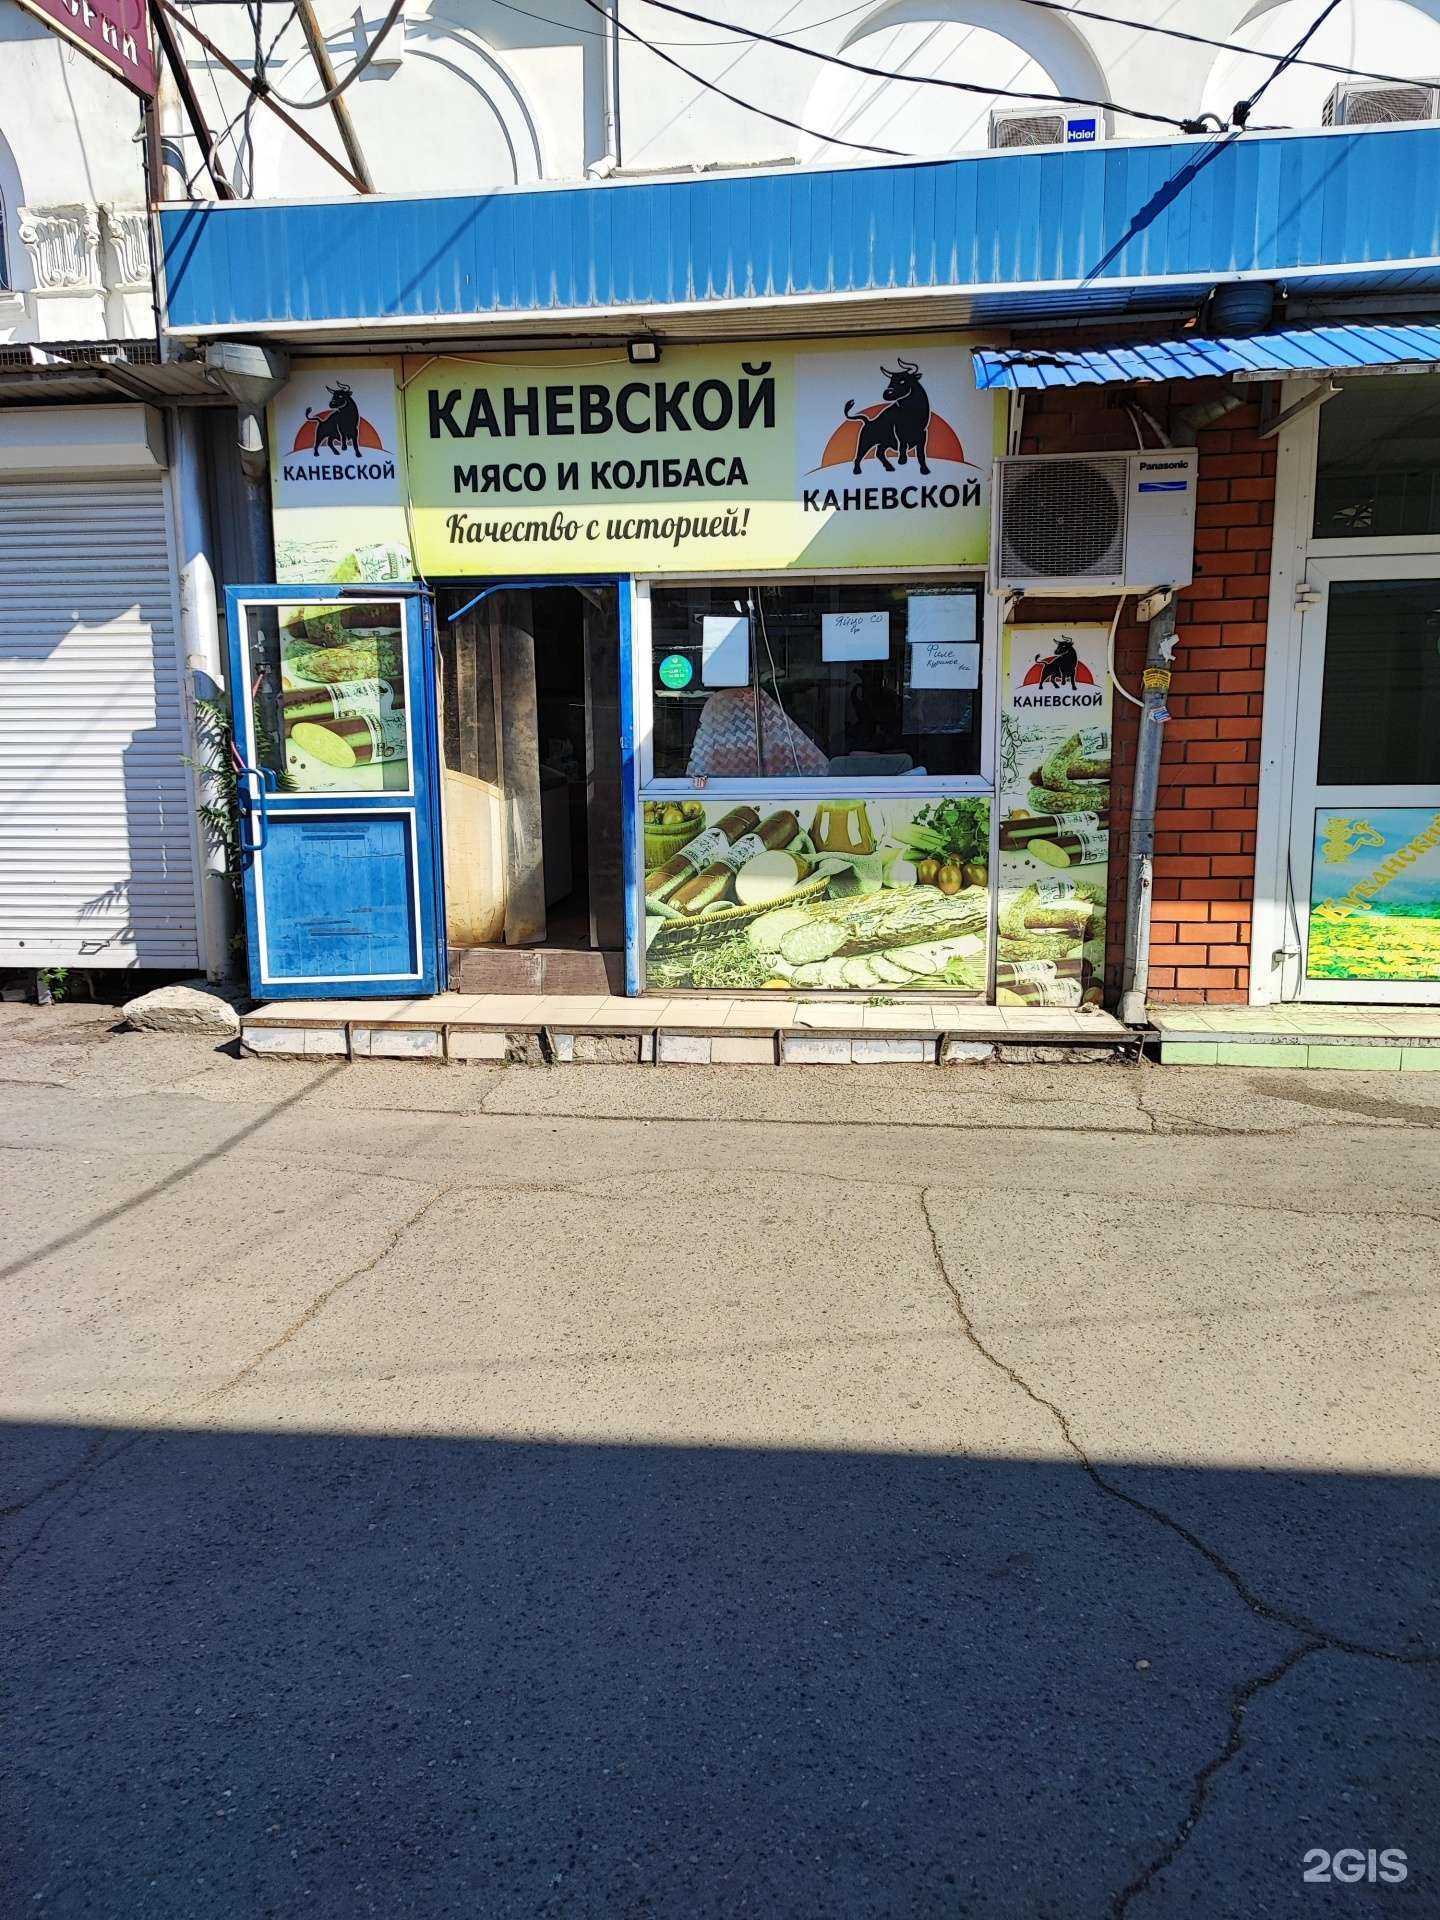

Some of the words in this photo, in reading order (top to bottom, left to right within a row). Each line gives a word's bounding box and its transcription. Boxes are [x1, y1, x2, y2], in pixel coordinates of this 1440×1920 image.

[1068, 130, 1095, 139] Haier
[428, 361, 776, 438] КАНЕВСКОЙ
[283, 460, 395, 481] КАНЕВСКОЙ
[453, 463, 546, 493] МЯСО
[557, 462, 579, 490] И
[591, 457, 749, 490] КОЛБАСА
[1140, 461, 1188, 471] Panasonic
[803, 478, 981, 512] КАНЕВСКОЙ
[446, 511, 583, 544] Качество
[586, 520, 600, 541] с
[606, 508, 751, 548] историей!
[1013, 692, 1103, 708] КАНЕВСКОЙ
